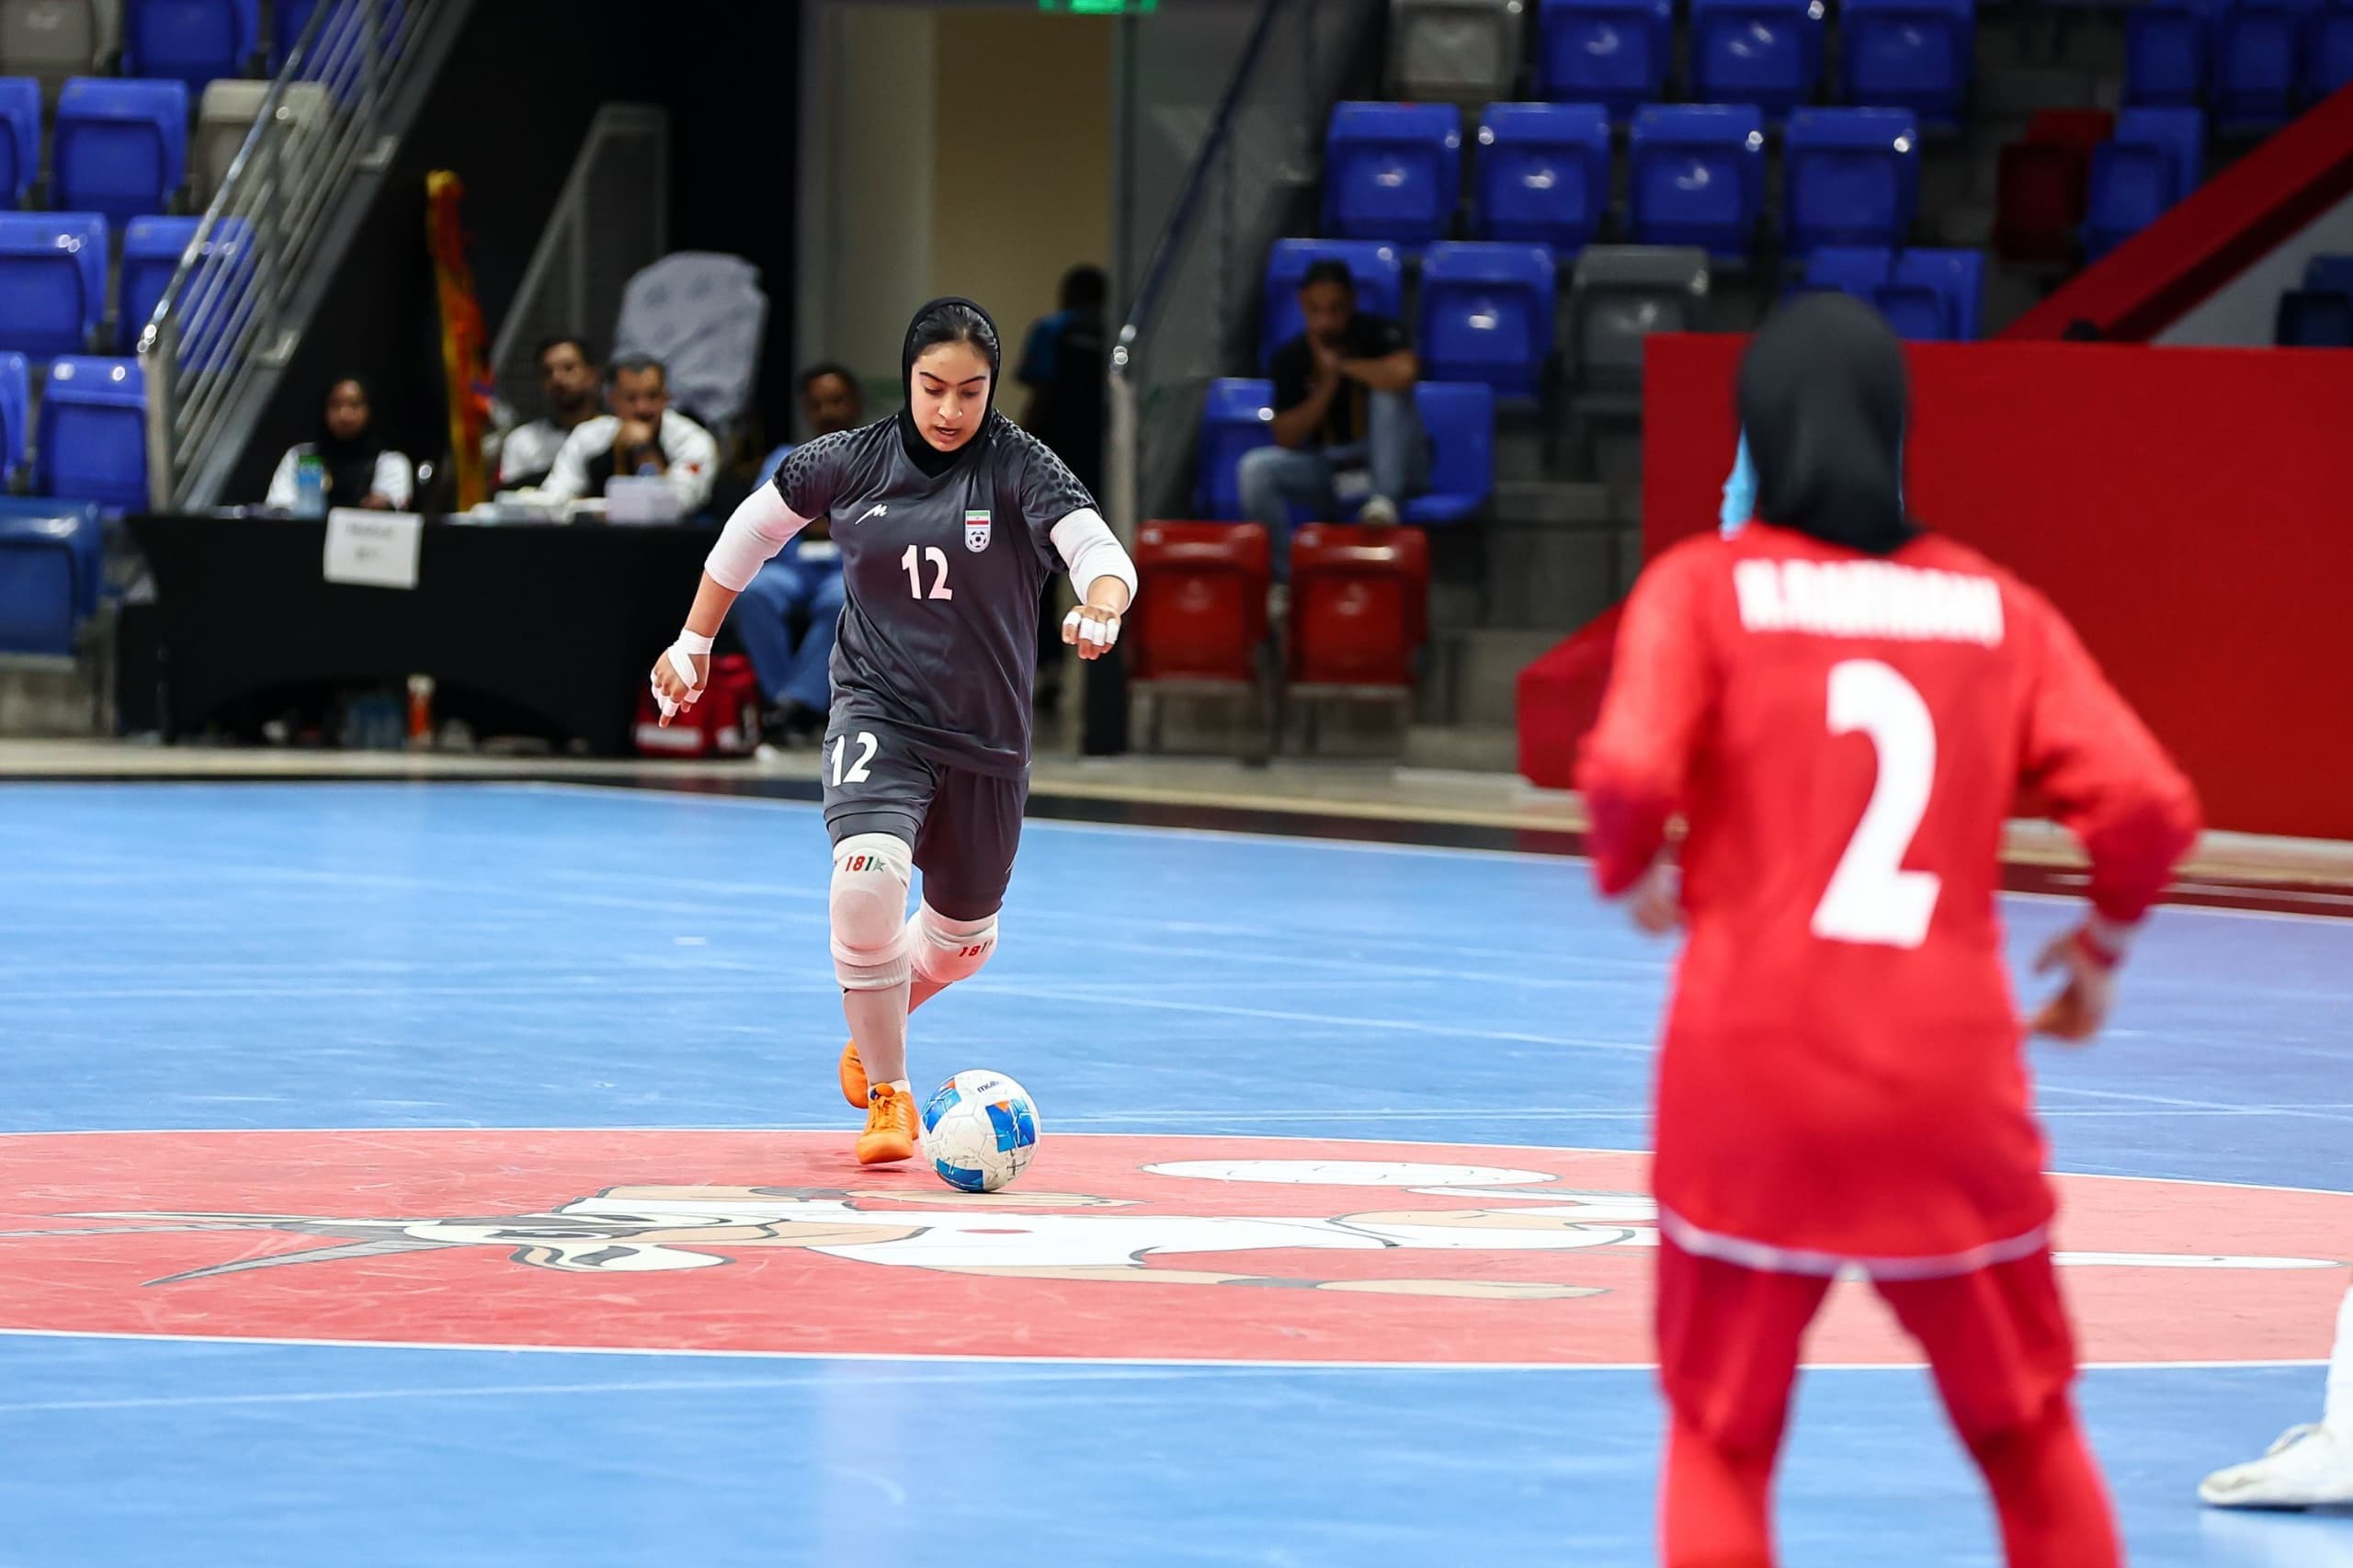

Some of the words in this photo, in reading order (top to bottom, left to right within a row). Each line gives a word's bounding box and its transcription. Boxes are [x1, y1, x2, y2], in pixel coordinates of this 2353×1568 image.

[901, 544, 953, 601] 12
[830, 731, 879, 788] 12
[1809, 658, 1942, 949] 2
[845, 856, 874, 872] 181
